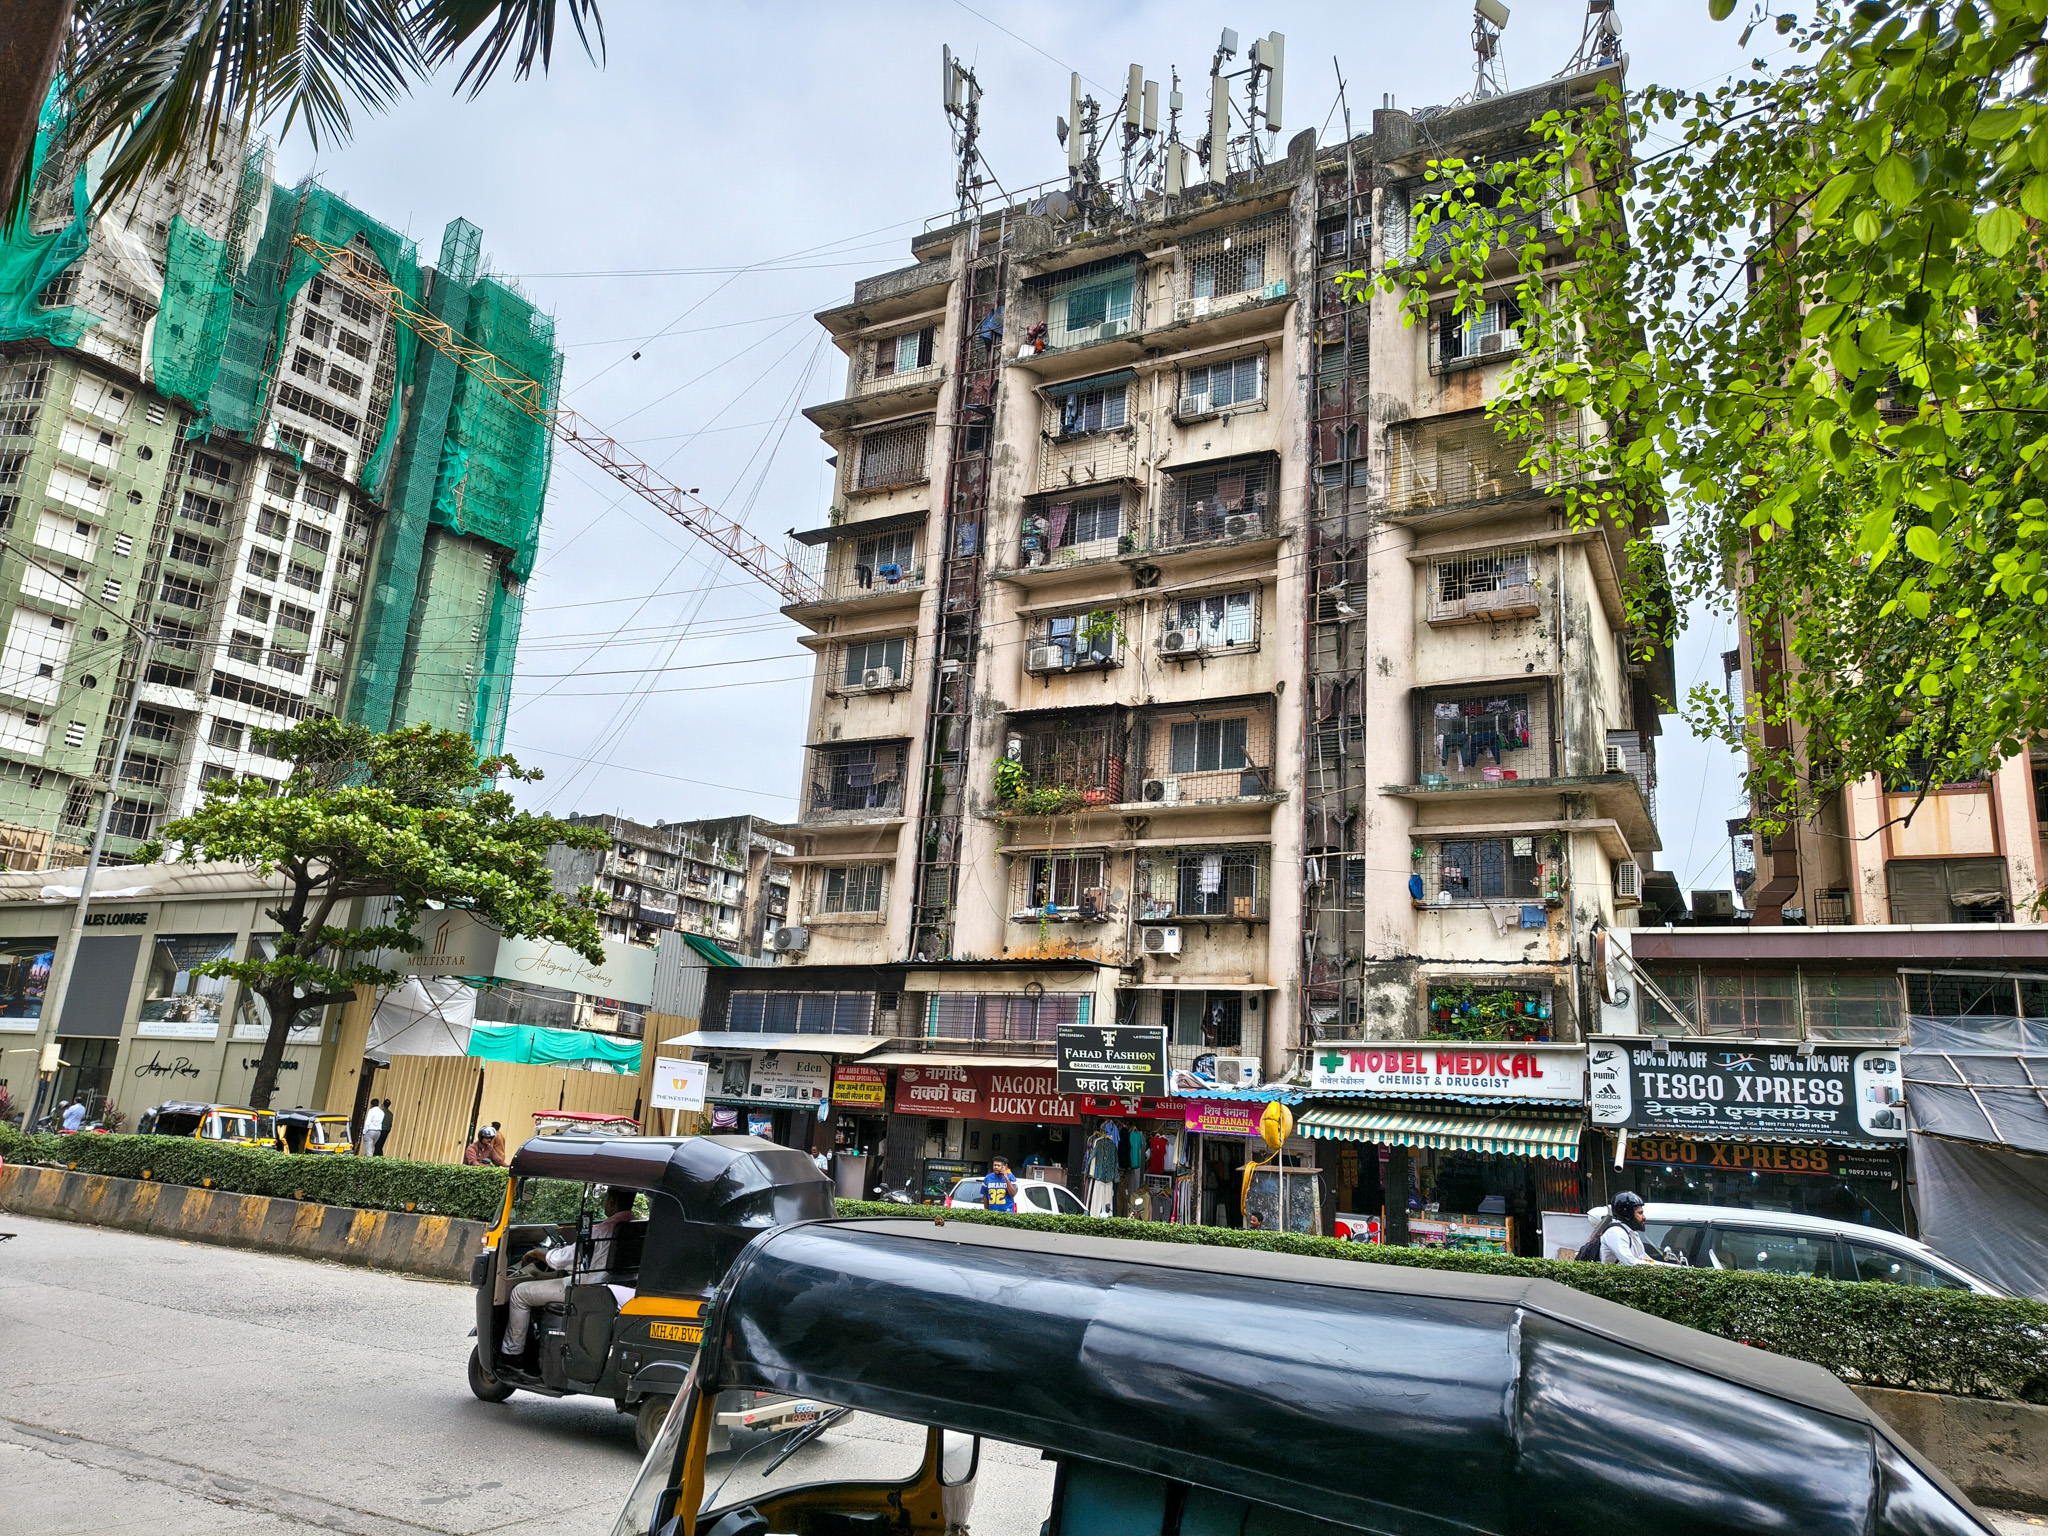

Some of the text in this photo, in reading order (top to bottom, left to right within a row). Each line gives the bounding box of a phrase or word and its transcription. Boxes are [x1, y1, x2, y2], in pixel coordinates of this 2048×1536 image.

[106, 913, 148, 925] LOUNGE
[407, 956, 466, 967] MULTISTAR
[515, 944, 613, 987] Autograph Residency
[1064, 1047, 1156, 1062] FAHAD FASHION
[1596, 1050, 1615, 1059] NIKE
[1633, 1050, 1708, 1068] 50% to 70% OFF
[1769, 1054, 1850, 1073] 50% to 70% OFF
[134, 1050, 172, 1078] Autograph
[797, 1061, 822, 1072] Eden
[1350, 1050, 1544, 1079] NOBEL MEDICAL
[991, 1075, 1052, 1095] NAGORI
[1075, 1075, 1145, 1093] फहाद फॅशन
[1378, 1075, 1510, 1088] CHEMIST & DRUGGIST
[1593, 1072, 1615, 1080] PUMA
[1638, 1072, 1844, 1106] TESCO XPRESS
[990, 1097, 1075, 1117] LUCKY CHAI
[1084, 1097, 1116, 1107] FAD
[1644, 1100, 1839, 1122] टेस्को एक्सप्रेस
[1198, 1115, 1254, 1127] SHIV BANANA
[1606, 1138, 1829, 1171] TESCO XPRESS
[988, 1189, 1006, 1205] 32
